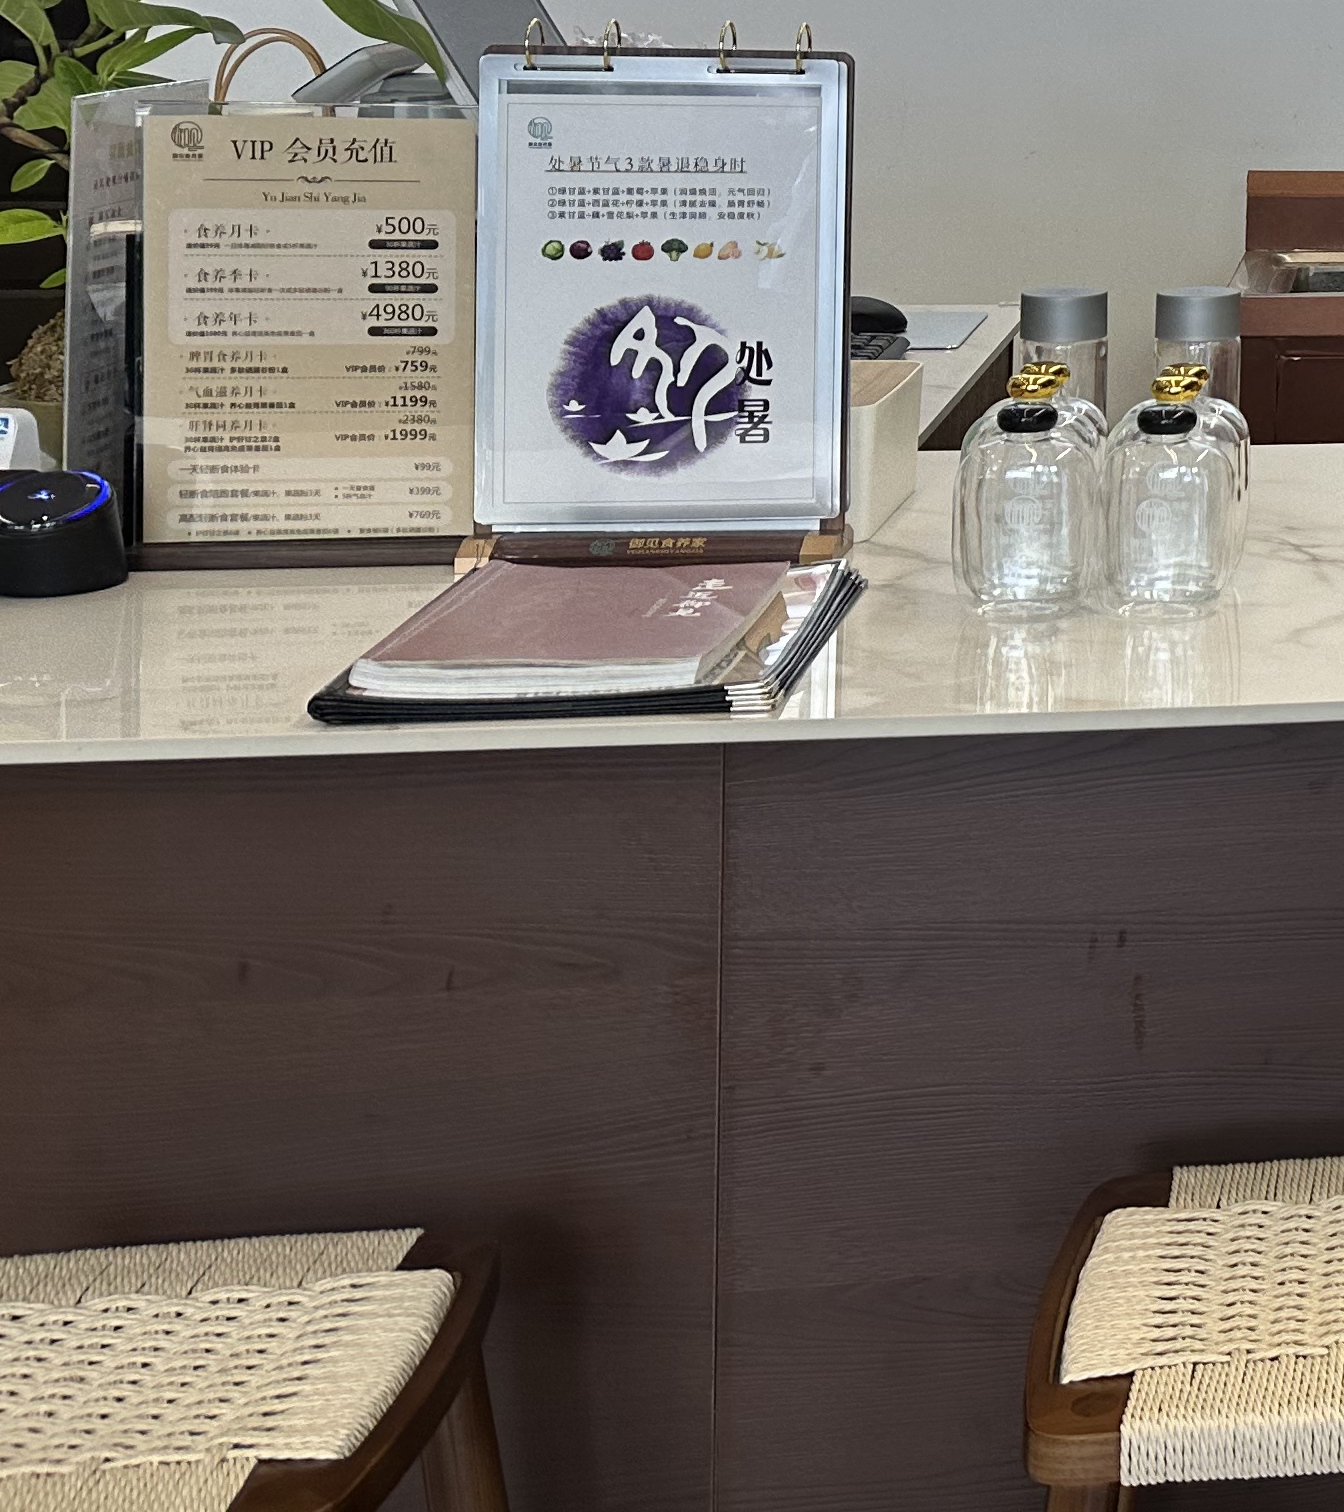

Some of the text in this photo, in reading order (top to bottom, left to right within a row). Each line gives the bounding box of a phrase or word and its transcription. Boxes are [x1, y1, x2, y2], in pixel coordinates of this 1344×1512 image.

[231, 138, 398, 164] VIP 会员充值
[197, 216, 439, 238] 食养月卡 ¥500元
[361, 261, 439, 280] ¥1380元
[196, 303, 438, 327] 食养年卡 ¥4980元
[735, 340, 773, 444] 处暑
